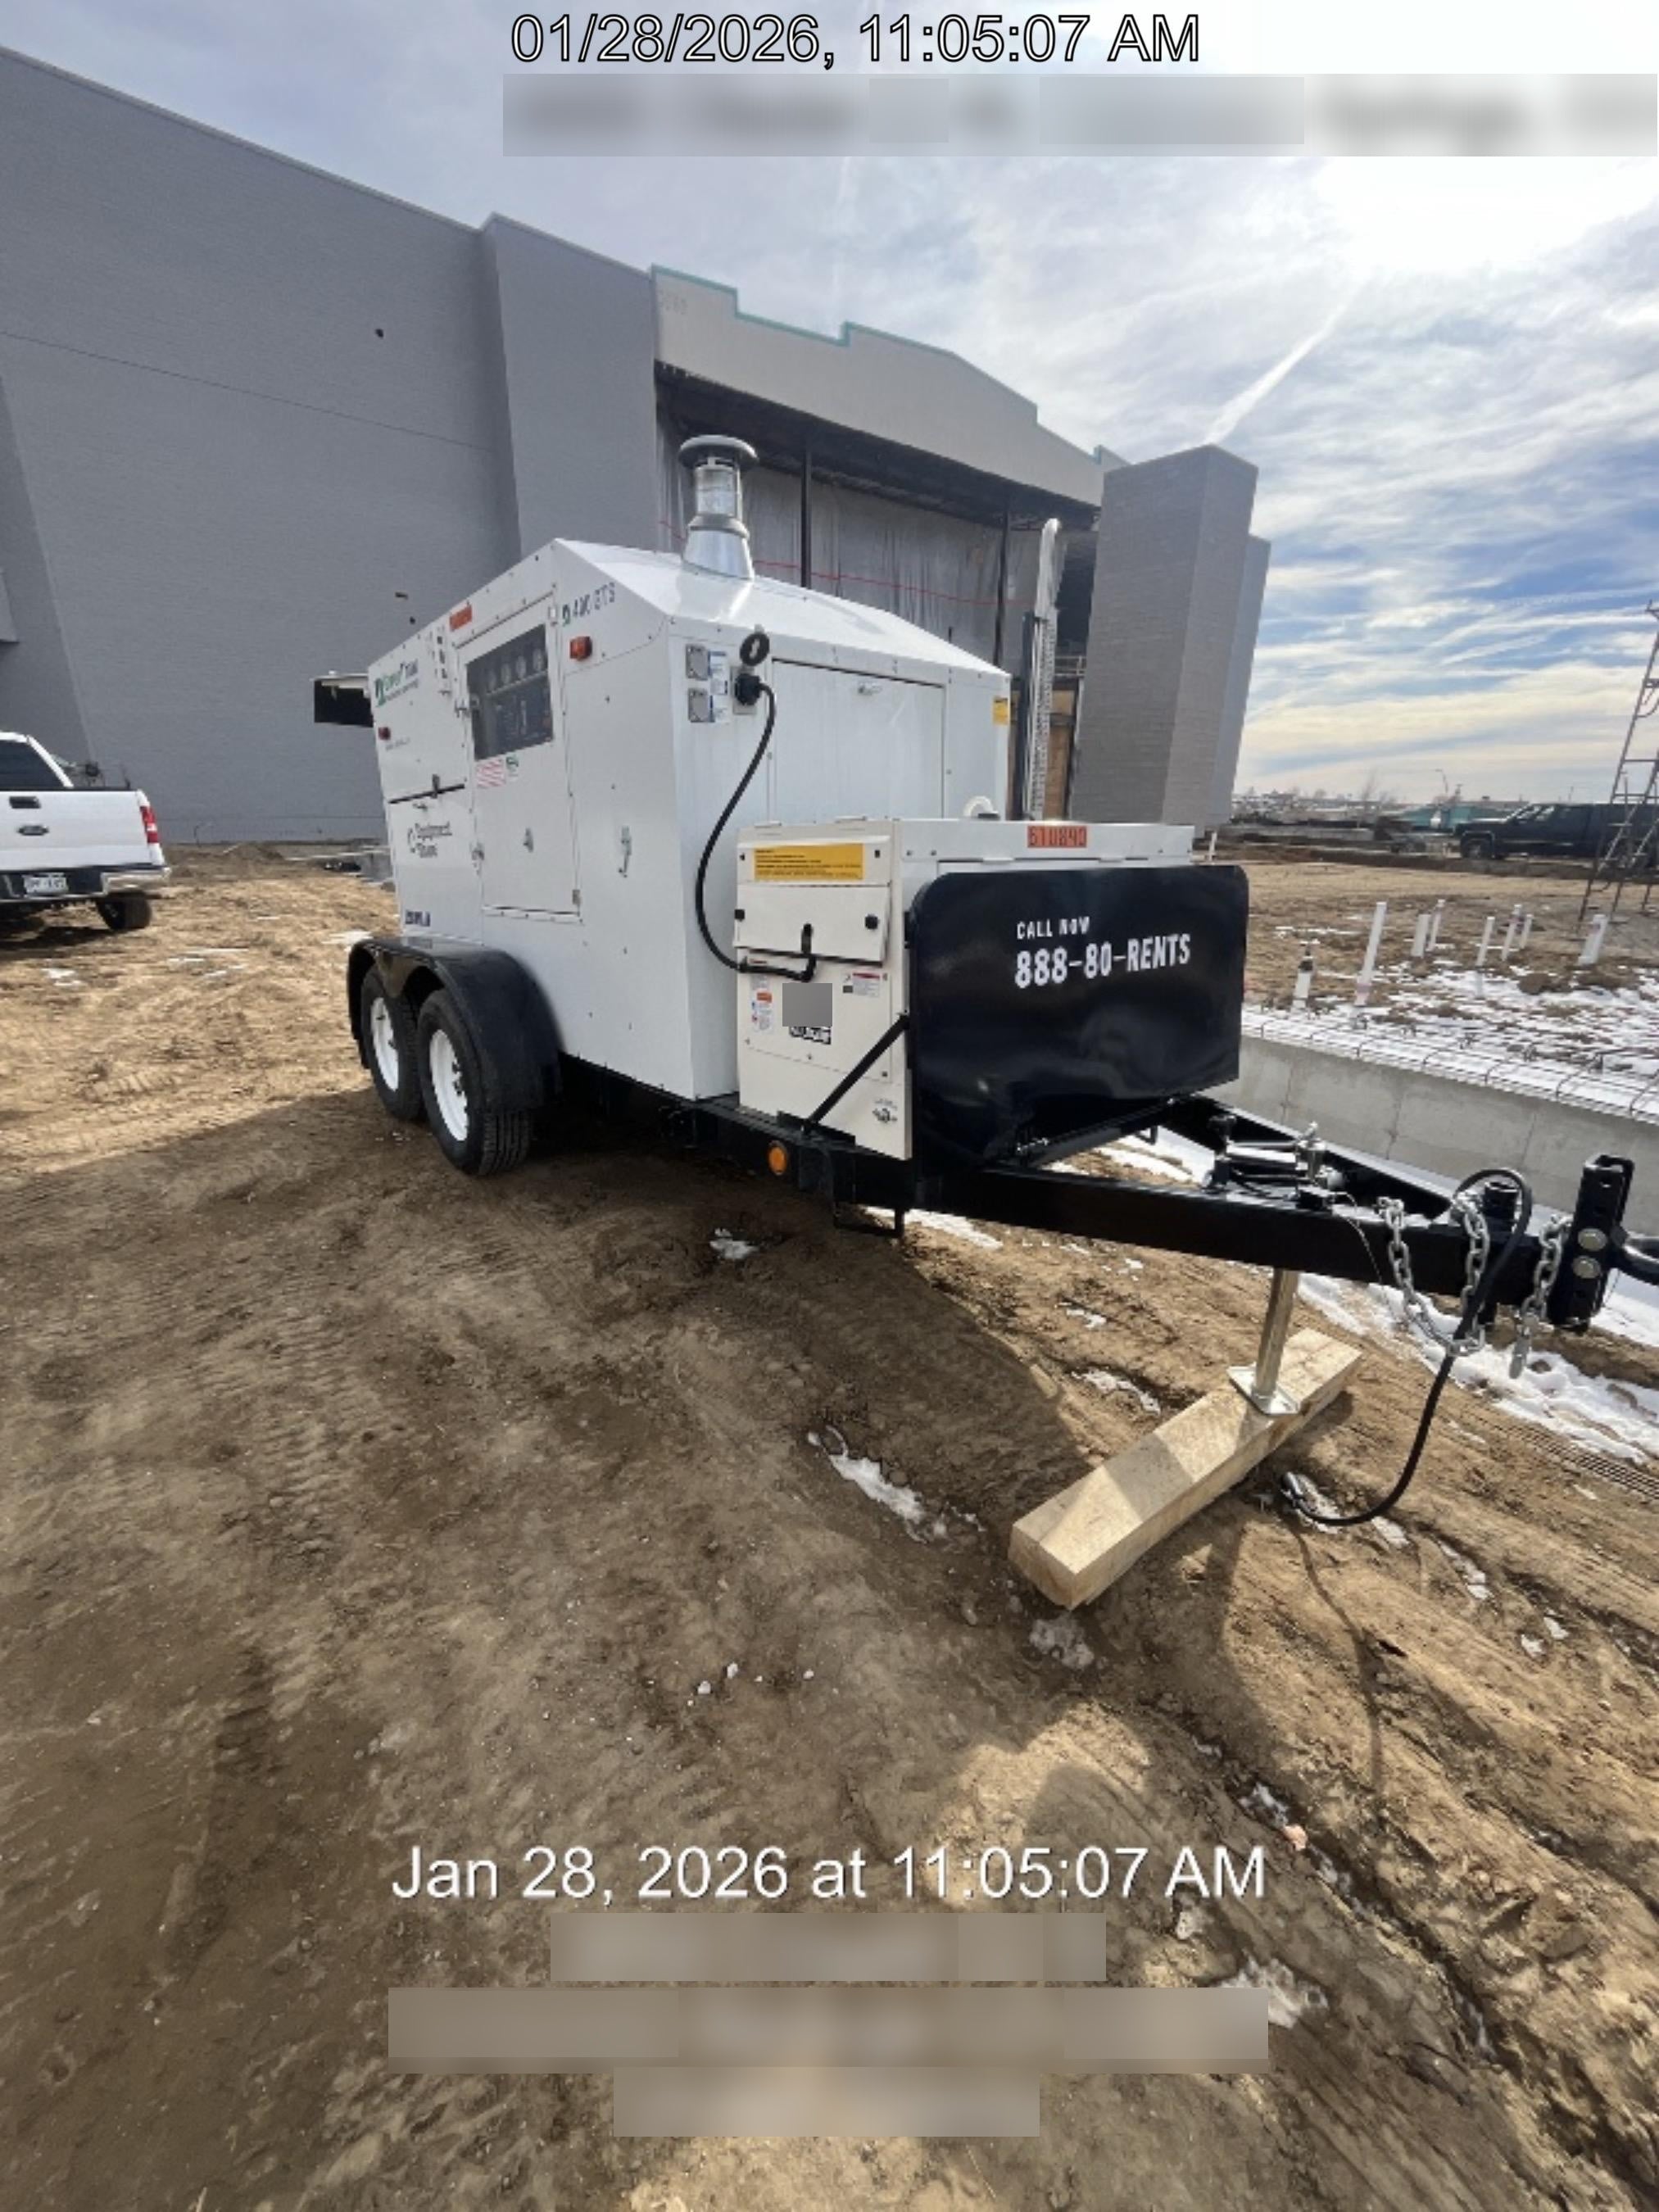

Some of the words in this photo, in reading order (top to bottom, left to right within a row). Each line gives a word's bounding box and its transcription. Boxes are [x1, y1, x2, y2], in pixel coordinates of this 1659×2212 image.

[1017, 919, 1054, 940] CALL
[1058, 916, 1090, 935] NOW
[1014, 933, 1191, 988] 888-80-RENTS
